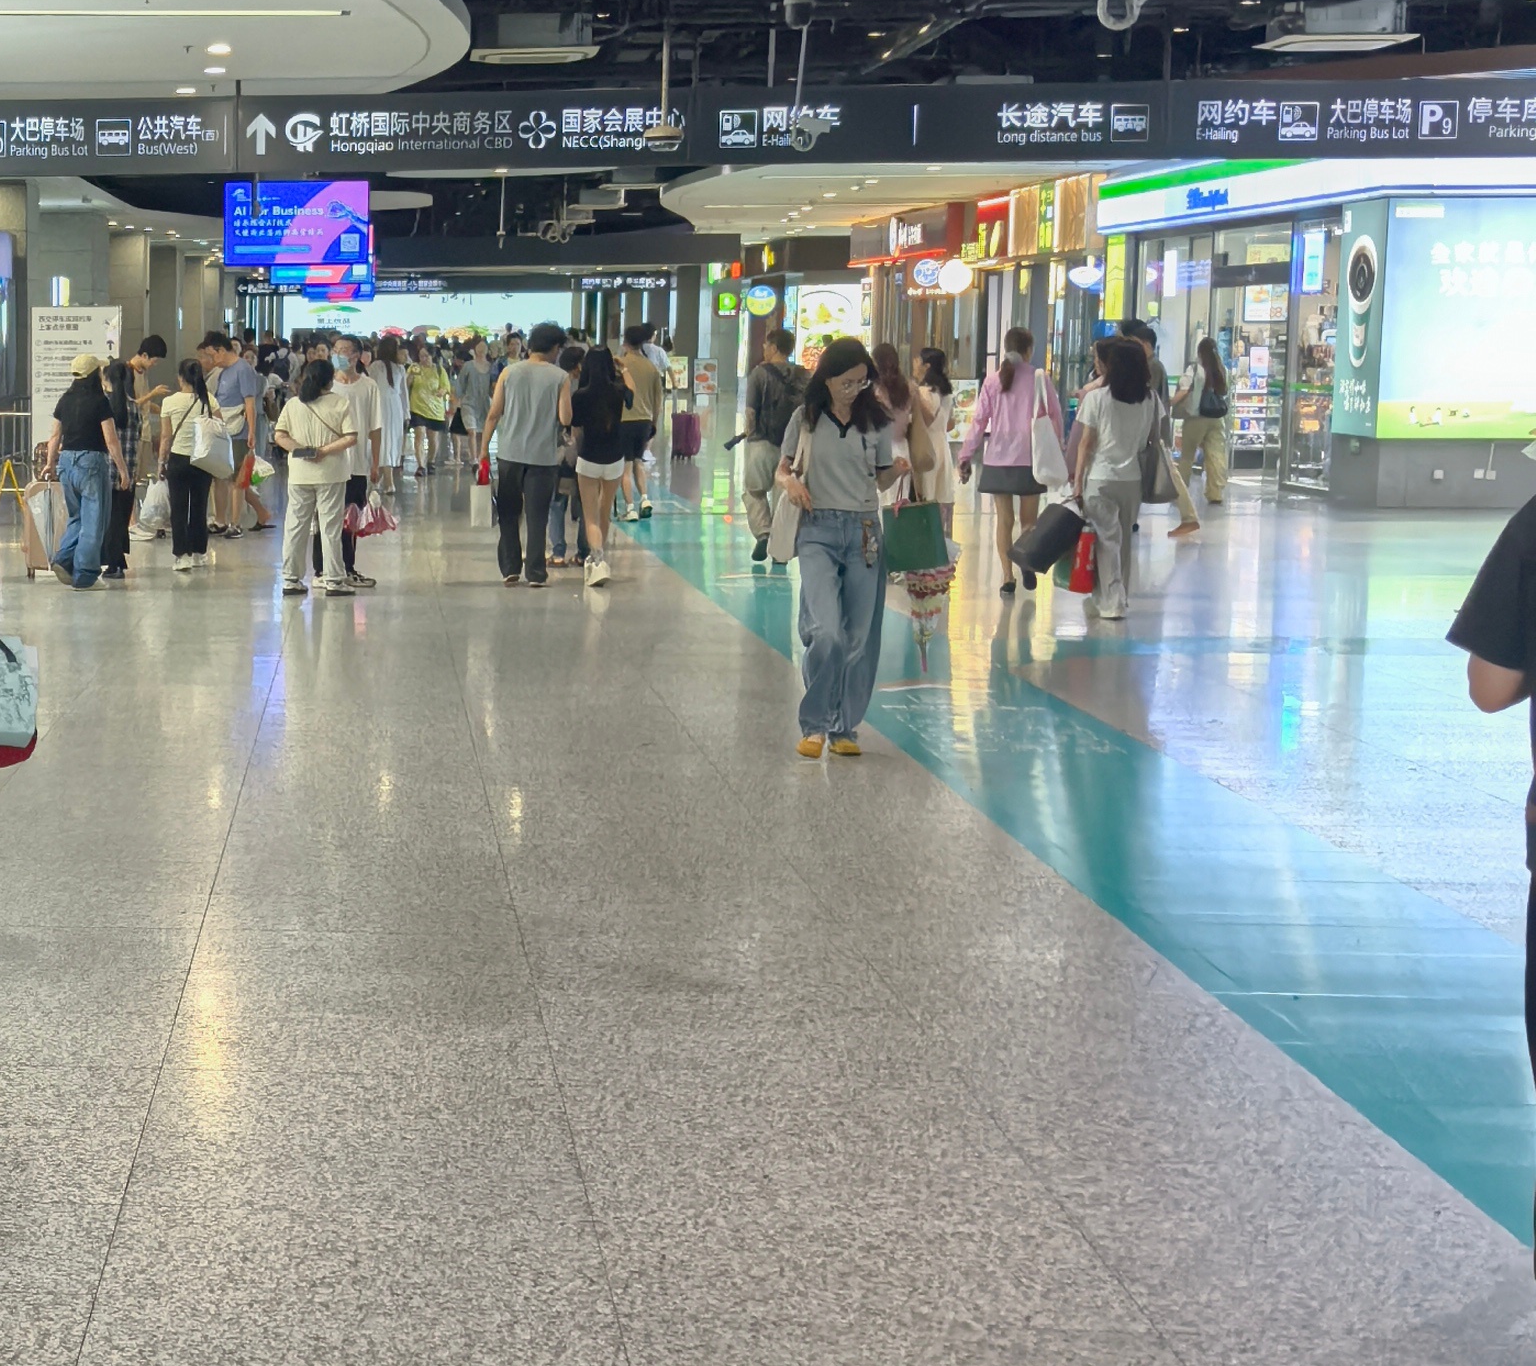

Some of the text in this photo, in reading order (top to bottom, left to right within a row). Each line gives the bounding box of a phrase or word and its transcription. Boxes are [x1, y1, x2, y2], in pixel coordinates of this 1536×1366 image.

[997, 102, 1104, 127] 长途汽车
[1198, 100, 1276, 125] 网约车
[1330, 98, 1412, 125] 大巴停车场
[11, 117, 85, 143] 大巴停车场
[330, 110, 513, 137] 虹桥国际中央商务区
[997, 129, 1102, 146] Long distance bus
[1196, 126, 1238, 144] E-Hailing
[1326, 125, 1410, 142] Parking Bus Lot
[10, 143, 89, 159] Parking Bus Lot
[138, 142, 198, 156] Bus(West)
[330, 137, 513, 155] Hongqiao International CBD
[272, 205, 324, 216] Business
